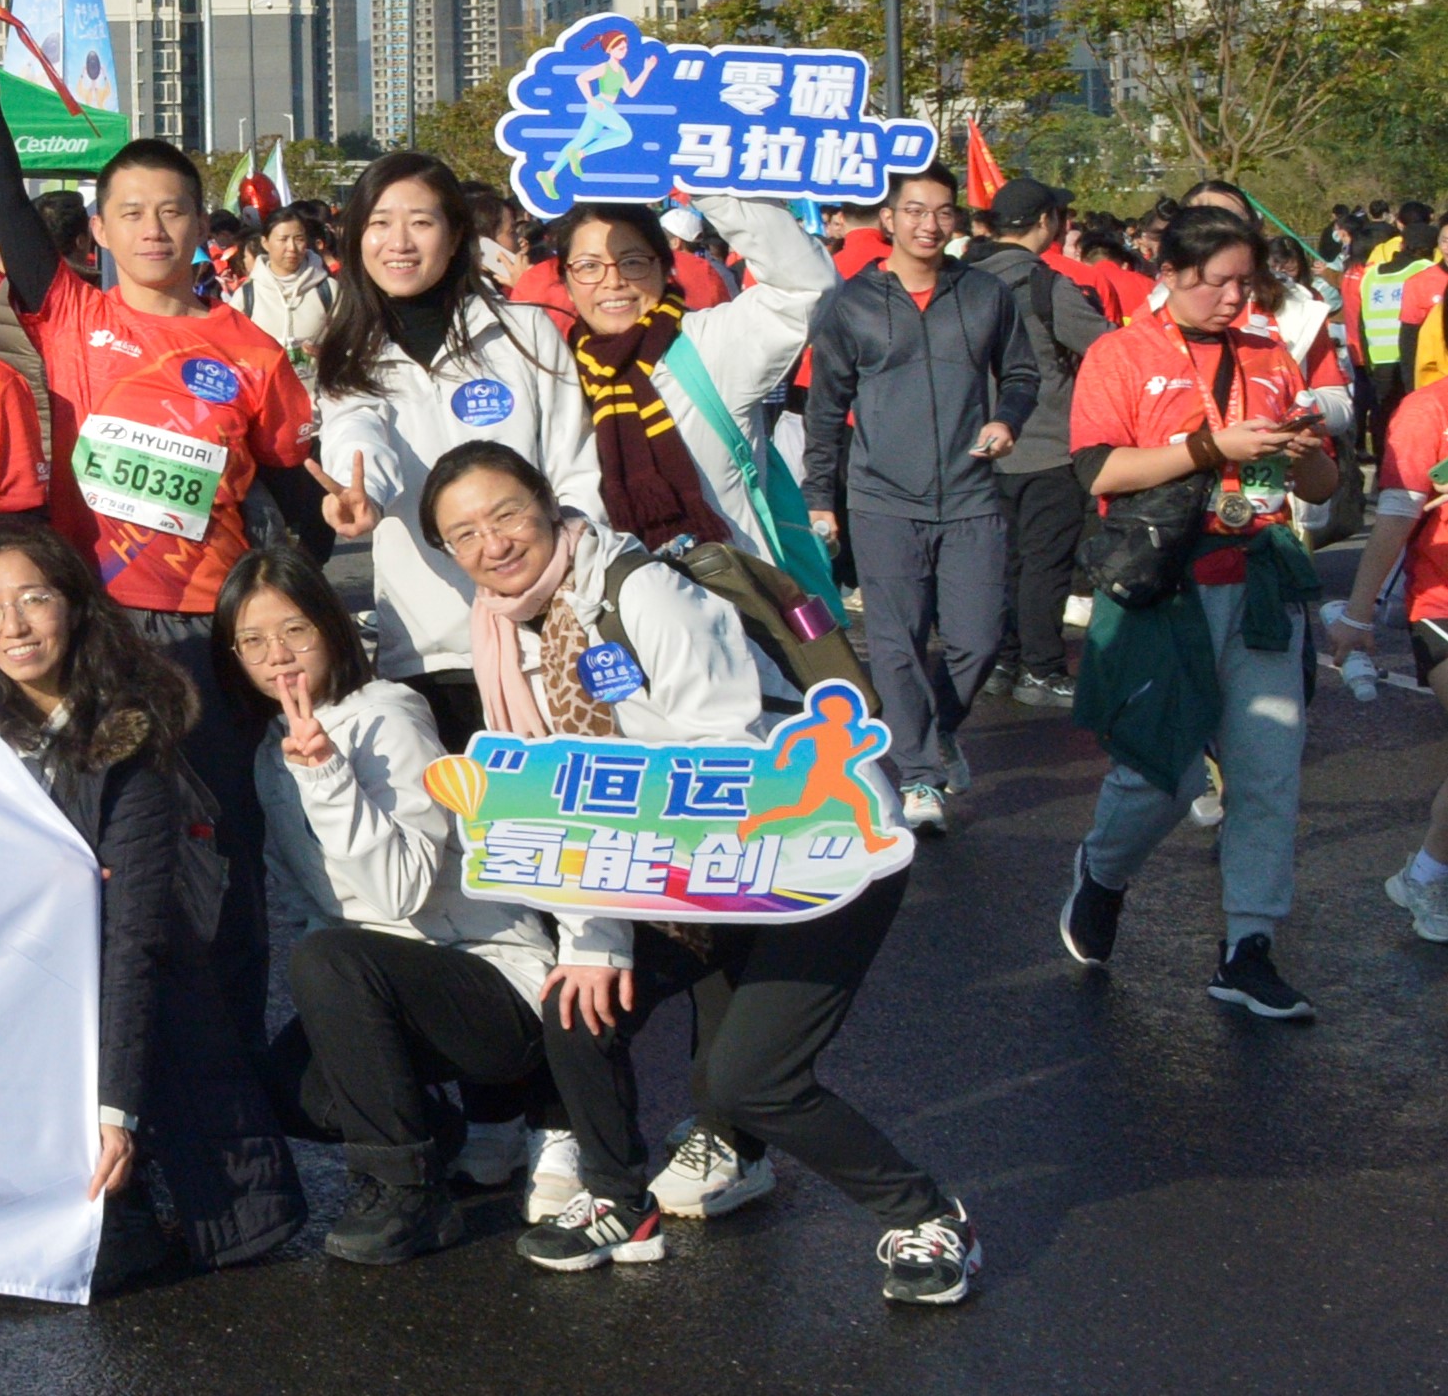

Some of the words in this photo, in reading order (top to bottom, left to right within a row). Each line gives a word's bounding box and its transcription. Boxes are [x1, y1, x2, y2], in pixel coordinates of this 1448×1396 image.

[131, 431, 213, 464] HYUNDAI
[113, 458, 204, 506] 50338
[1242, 465, 1273, 487] 82
